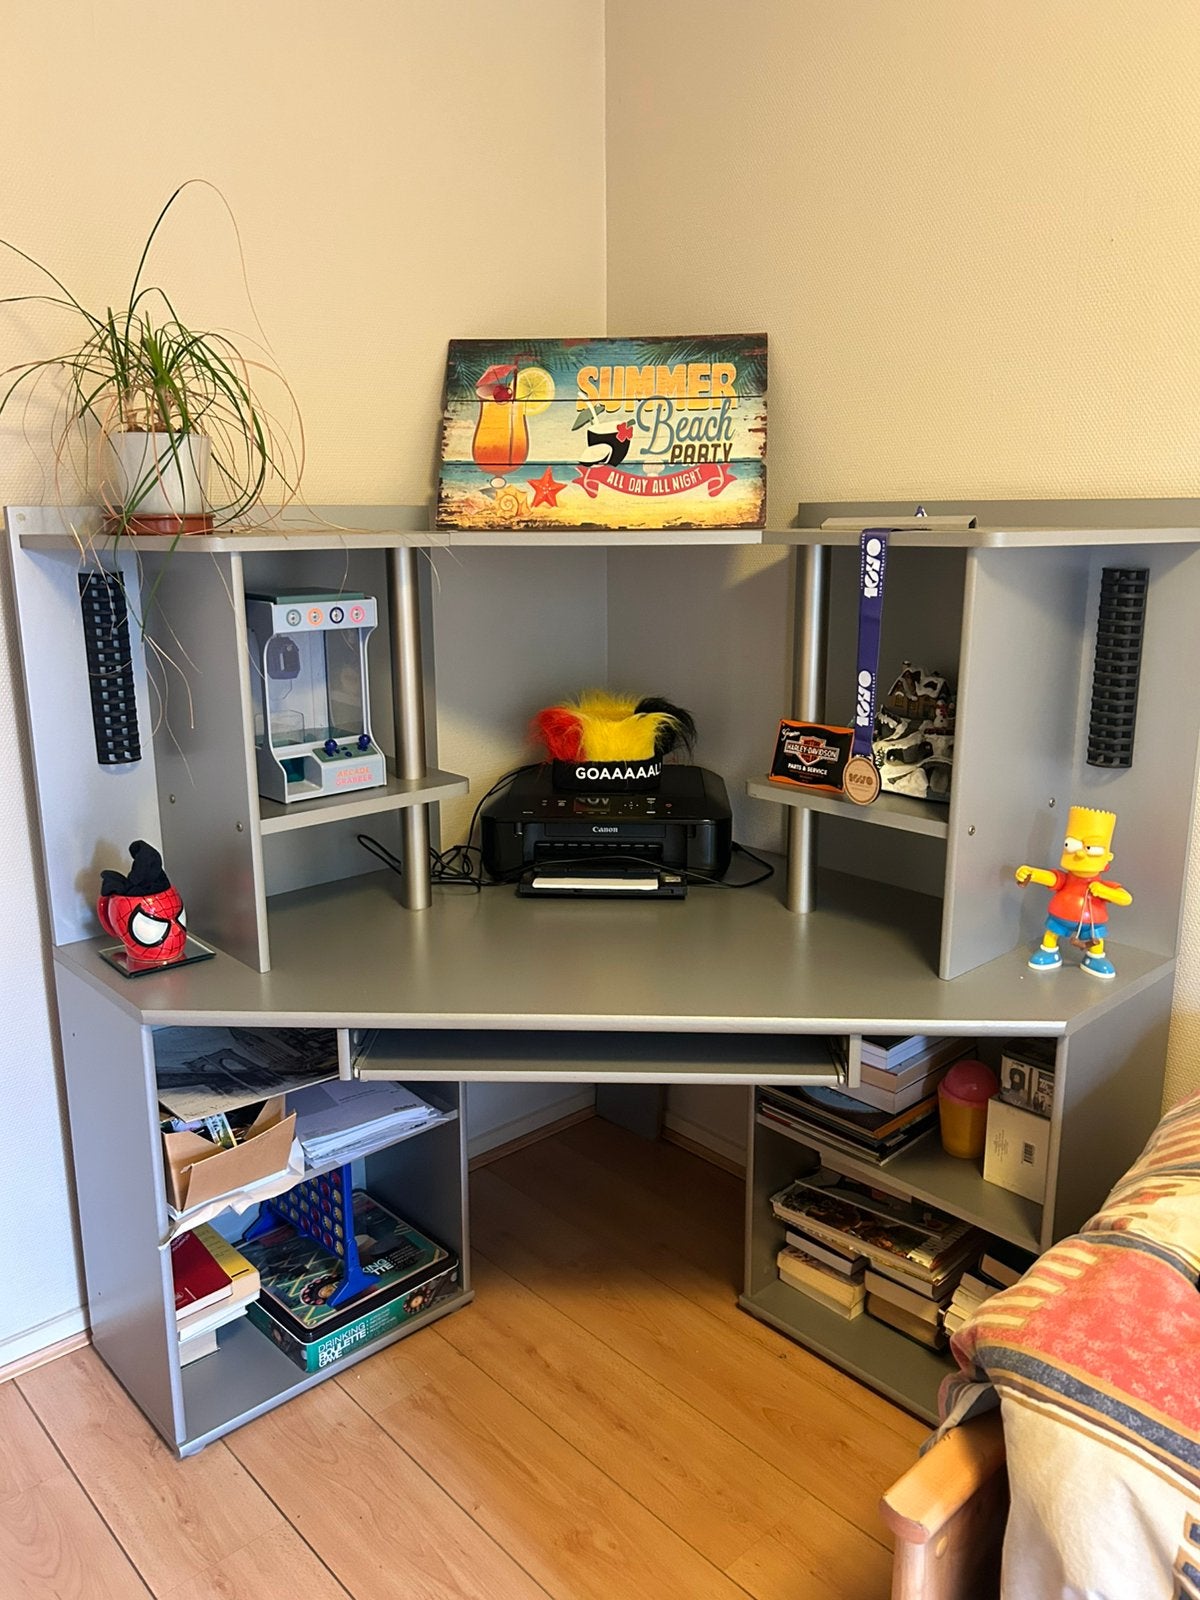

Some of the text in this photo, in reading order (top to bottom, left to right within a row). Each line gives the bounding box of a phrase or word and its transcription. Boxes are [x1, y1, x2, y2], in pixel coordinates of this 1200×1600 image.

[577, 363, 738, 413] SUMMER
[636, 395, 735, 455] Beach
[670, 443, 733, 464] PARTY
[607, 467, 702, 494] ALL DAY ALL NIGHT
[786, 743, 837, 758] HARLEY-DAVIDSON
[788, 763, 801, 771] PARTS
[807, 766, 828, 775] SERVICE
[318, 1322, 366, 1353] DRINKING
[319, 1331, 367, 1360] ROULETTE
[318, 1350, 342, 1367] GAME
